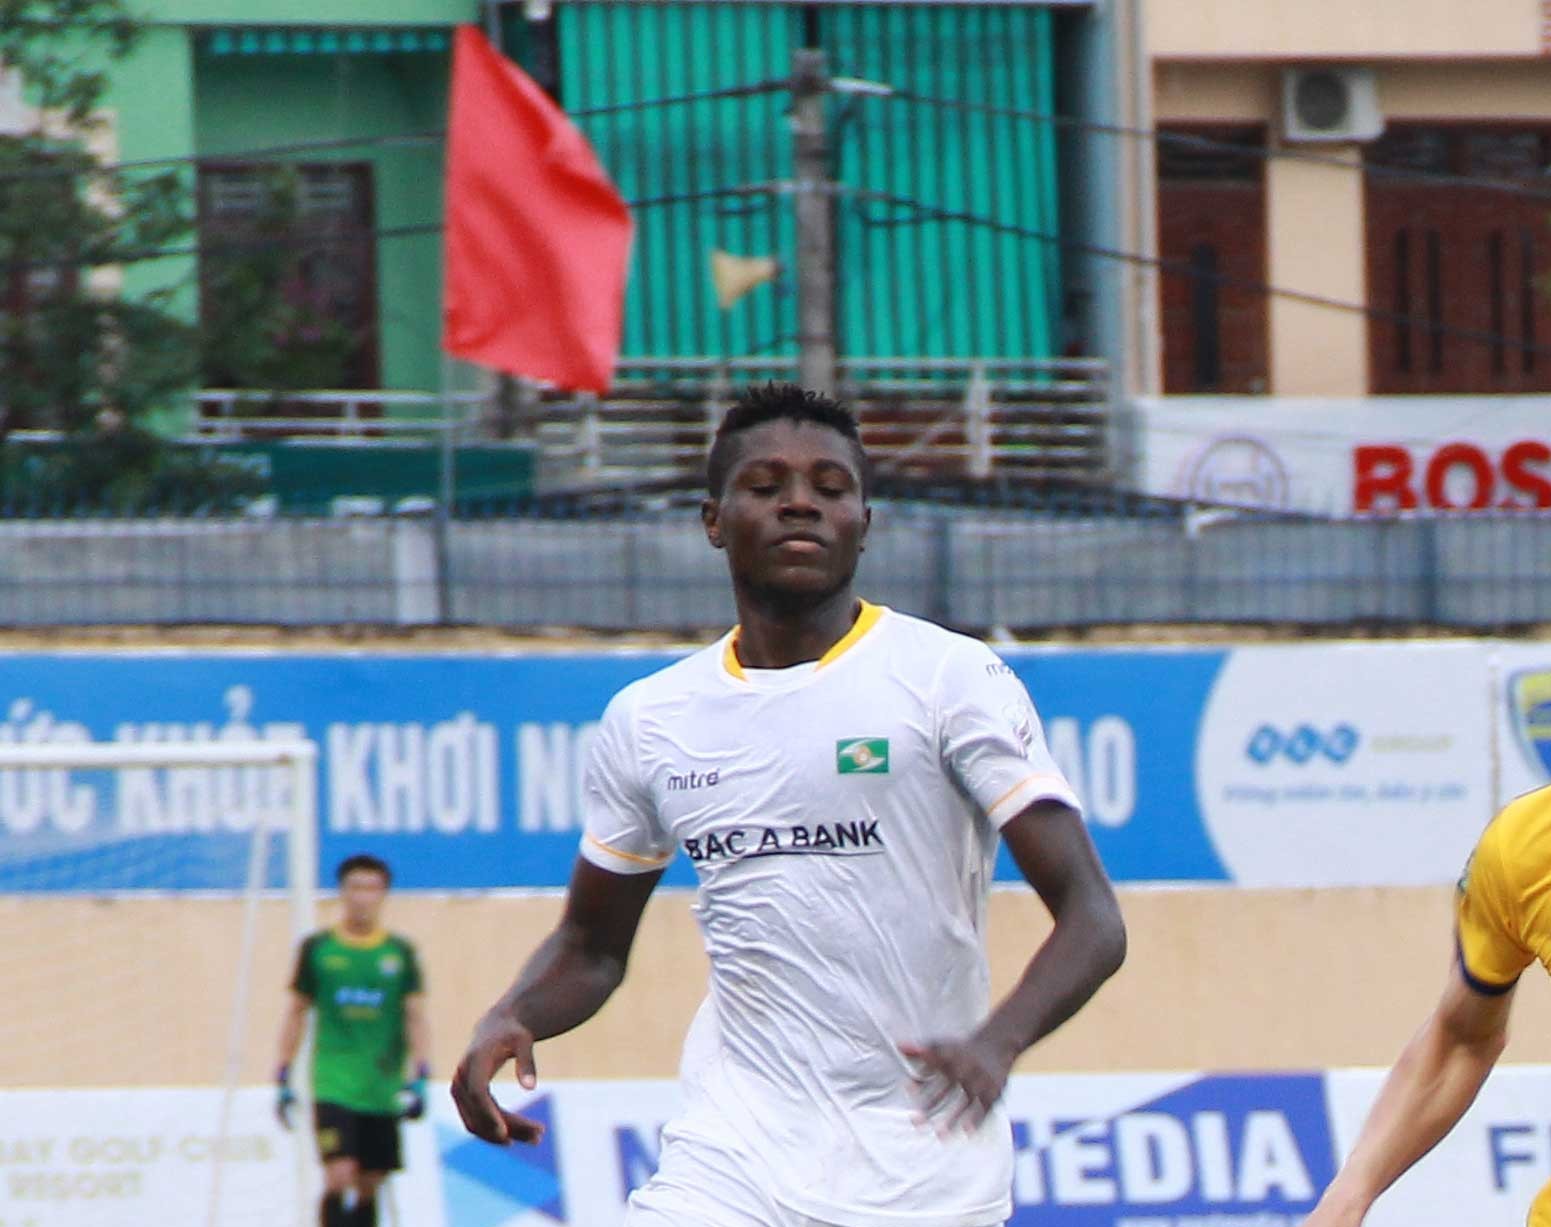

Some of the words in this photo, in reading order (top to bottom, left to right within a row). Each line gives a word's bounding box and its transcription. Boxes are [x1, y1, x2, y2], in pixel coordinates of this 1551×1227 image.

[667, 770, 720, 790] mitre
[684, 830, 745, 861] BAC
[758, 828, 780, 851] A
[791, 819, 885, 848] BANK
